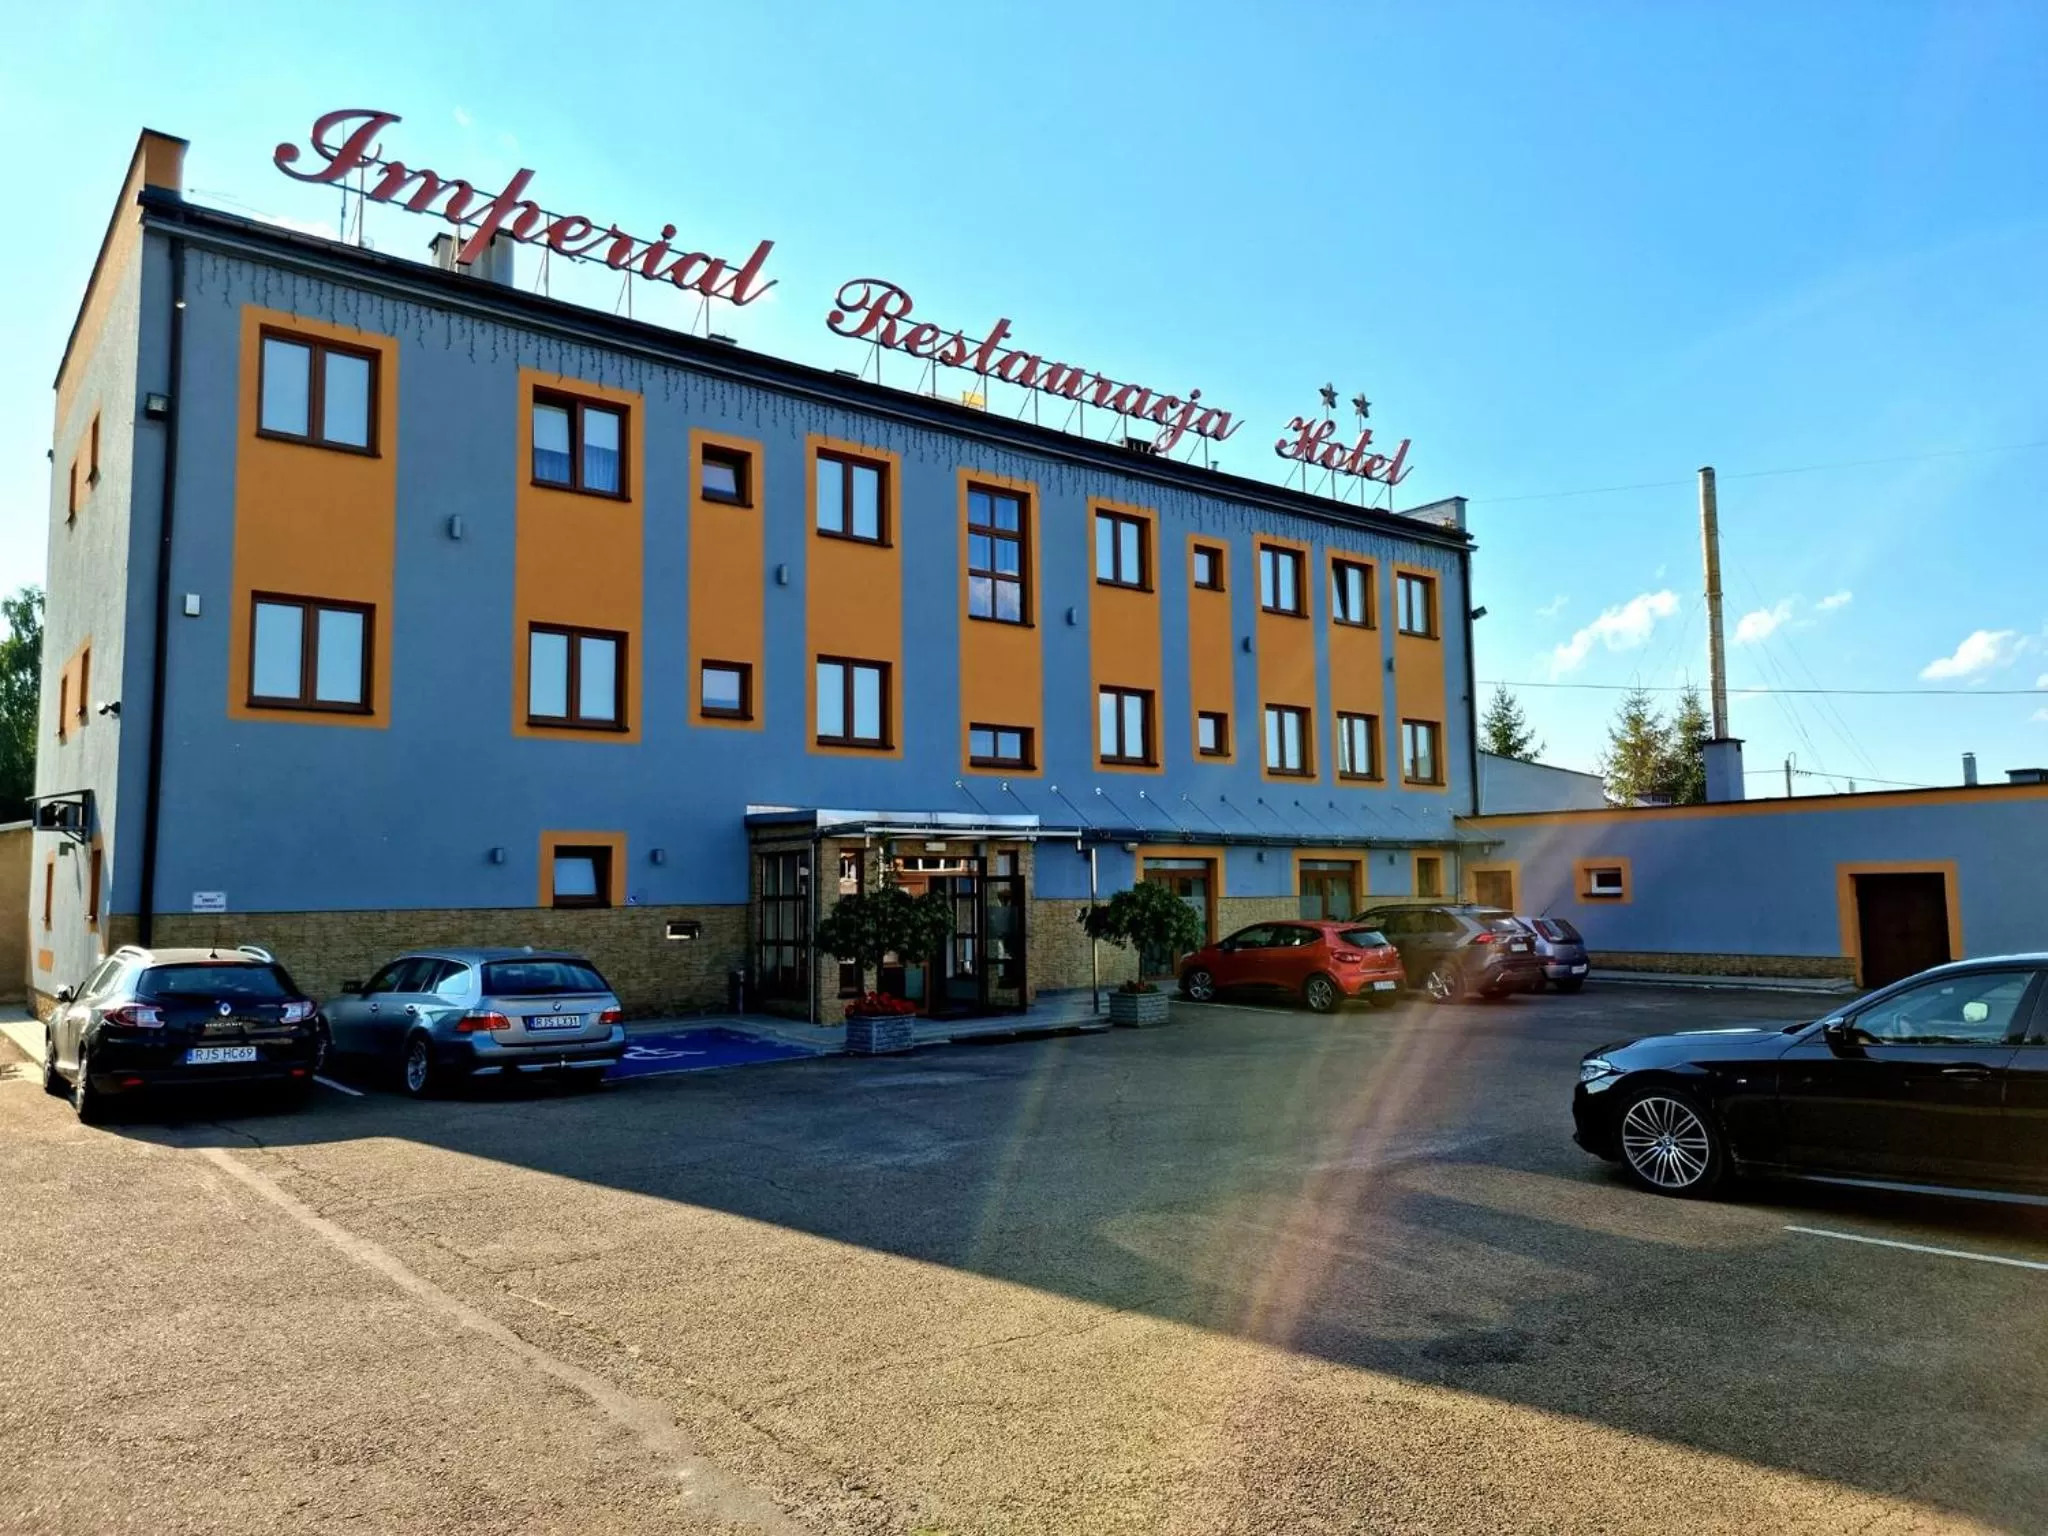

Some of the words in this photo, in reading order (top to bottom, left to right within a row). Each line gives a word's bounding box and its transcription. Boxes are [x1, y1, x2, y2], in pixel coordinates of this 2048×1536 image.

[273, 109, 779, 306] Imperial
[826, 278, 1245, 453] Restauracja
[1275, 416, 1414, 486] Hotel
[195, 1049, 220, 1061] RJS
[223, 1047, 254, 1060] HC69
